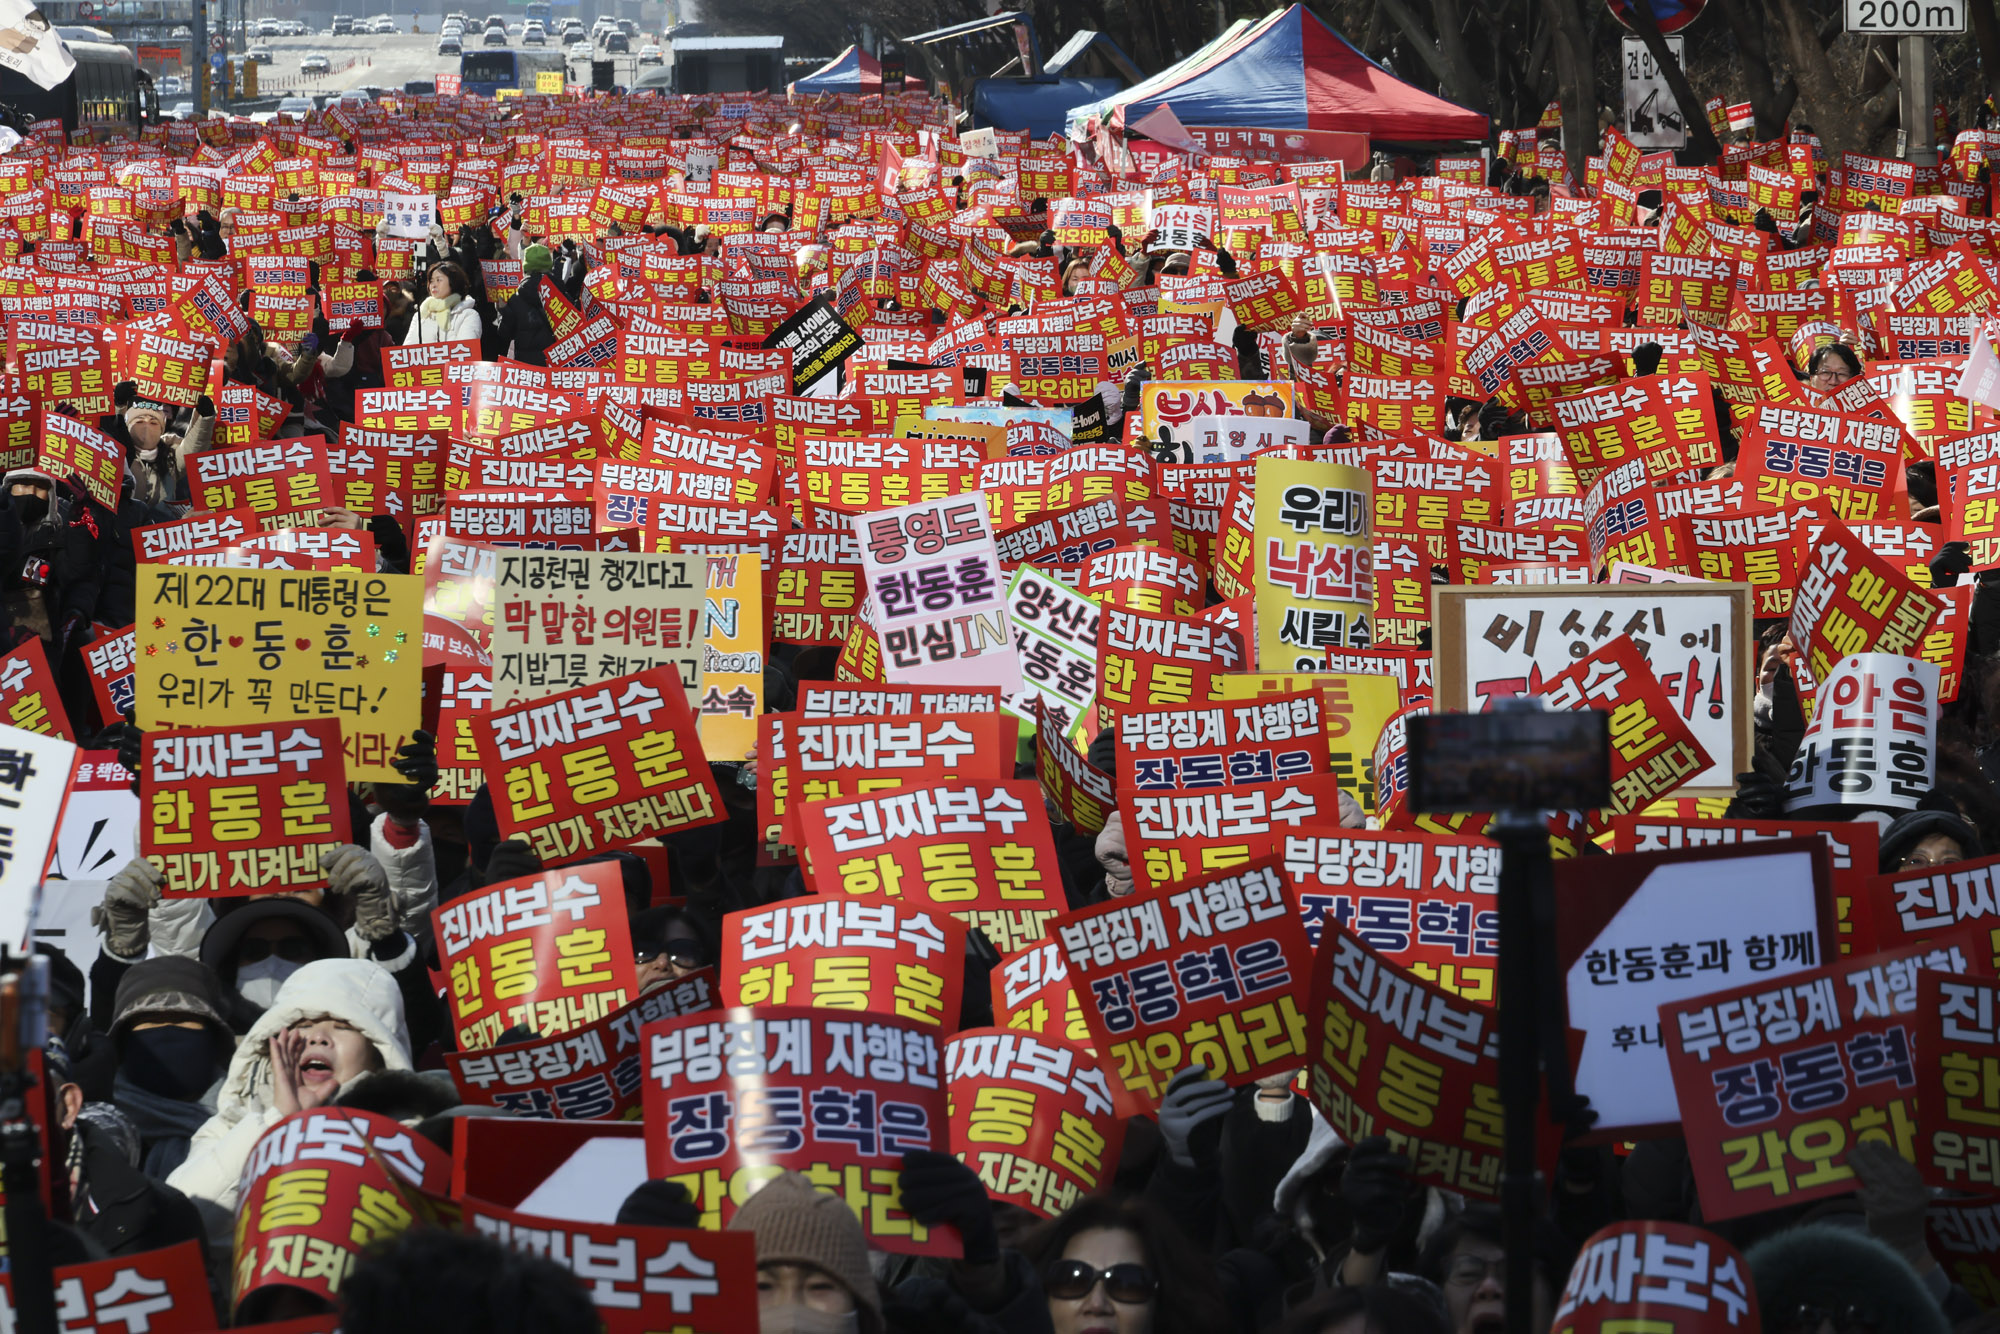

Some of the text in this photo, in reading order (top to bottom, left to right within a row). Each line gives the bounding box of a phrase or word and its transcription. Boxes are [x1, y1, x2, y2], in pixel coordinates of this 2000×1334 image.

[1858, 0, 1955, 28] 200m
[1439, 159, 1481, 172] 진짜보수
[1749, 165, 1796, 189] 진짜보수
[1844, 153, 1912, 179] 부당징계 자행한
[1847, 172, 1905, 195] 장동혁은
[1345, 194, 1402, 209] 진짜보수
[1495, 235, 1572, 267] 진짜보수
[1651, 257, 1731, 281] 진짜보수
[1765, 246, 1830, 272] 진짜보수
[1833, 246, 1899, 267] 진짜보수
[1226, 272, 1280, 302] 진짜보수
[1895, 250, 1965, 311] 진짜보수
[254, 294, 309, 310] 진짜보수
[16, 322, 94, 343] 진짜보수
[548, 314, 615, 369] 부당징계 자행한
[955, 319, 985, 348] 자행한
[998, 316, 1073, 335] 부당징계 자행한
[1142, 317, 1208, 337] 진짜보수
[1353, 324, 1434, 361] 진짜보수
[1889, 316, 1939, 337] 부당징계
[24, 345, 101, 372] 진짜보수
[140, 333, 210, 362] 진짜보수
[389, 342, 472, 369] 진짜보수
[624, 334, 710, 357] 진짜보수
[852, 342, 924, 362] 진짜보수
[1107, 346, 1138, 369] 에서
[1161, 343, 1232, 370] 진짜보수
[448, 364, 546, 389] 부당징계 자행한
[686, 373, 785, 403] 부당징계 자행한
[864, 372, 952, 395] 진짜보수
[1348, 376, 1435, 400] 진짜보수
[1517, 356, 1612, 386] 진짜보수
[221, 388, 253, 404] 자행한
[362, 389, 451, 413] 진짜보수
[642, 387, 682, 408] 자행한
[773, 397, 861, 426] 진짜보수
[1554, 384, 1649, 428] 진짜보수
[46, 414, 119, 459] 진짜보수
[501, 421, 591, 457] 진짜보수
[1758, 406, 1901, 454] 부당징계 자행한
[198, 440, 314, 483] 진짜보수
[652, 426, 764, 475] 진짜보수
[804, 440, 910, 469] 진짜보수
[1049, 449, 1150, 480] 진짜보수
[1766, 440, 1886, 487] 장동혁은
[481, 459, 592, 488] 진짜보수
[601, 462, 733, 503] 부당징계 자행한
[1376, 459, 1491, 493] 진짜보수
[1605, 456, 1645, 499] 자행한
[451, 504, 591, 536] 부당징계 자행한
[657, 501, 779, 538] 진짜보수
[1058, 499, 1119, 538] 자행한
[1279, 484, 1368, 539] 우리가
[142, 515, 245, 558] 진짜보수
[867, 503, 987, 565] 통영도
[1457, 524, 1579, 562] 진짜보수
[501, 557, 693, 590] 지공천권 챙긴다고
[874, 556, 995, 618] 한동훈
[1087, 549, 1200, 597] 진짜보수
[154, 571, 391, 618] 제22대 대통령은
[603, 606, 699, 649] 의원들!
[1107, 609, 1239, 667] 진짜보수
[1280, 608, 1346, 648] 시킬
[500, 652, 588, 688] 지밥그릇
[158, 673, 388, 714] 우리가 꼭 만든다!
[491, 681, 664, 761] 진짜보수
[1121, 697, 1319, 752] 부당징계 자행한
[152, 728, 323, 782] 진짜보수
[798, 720, 975, 772] 진짜보수
[601, 784, 714, 842] 지켜낸다
[824, 785, 1028, 854] 진짜보수
[1133, 785, 1317, 841] 진짜보수
[1284, 835, 1422, 890] 부당징계
[440, 875, 600, 957] 진짜보수
[740, 901, 946, 963] 진짜보수
[1059, 866, 1287, 972] 부당징계 자행한
[1585, 930, 1816, 986] 한동훈과 함께
[1091, 938, 1292, 1034] 장동혁은
[1678, 978, 1840, 1062] 부당징계
[459, 1032, 605, 1089] 부당징계
[650, 1016, 939, 1090] 부당징계 자행한
[668, 1087, 930, 1161] 장동혁은
